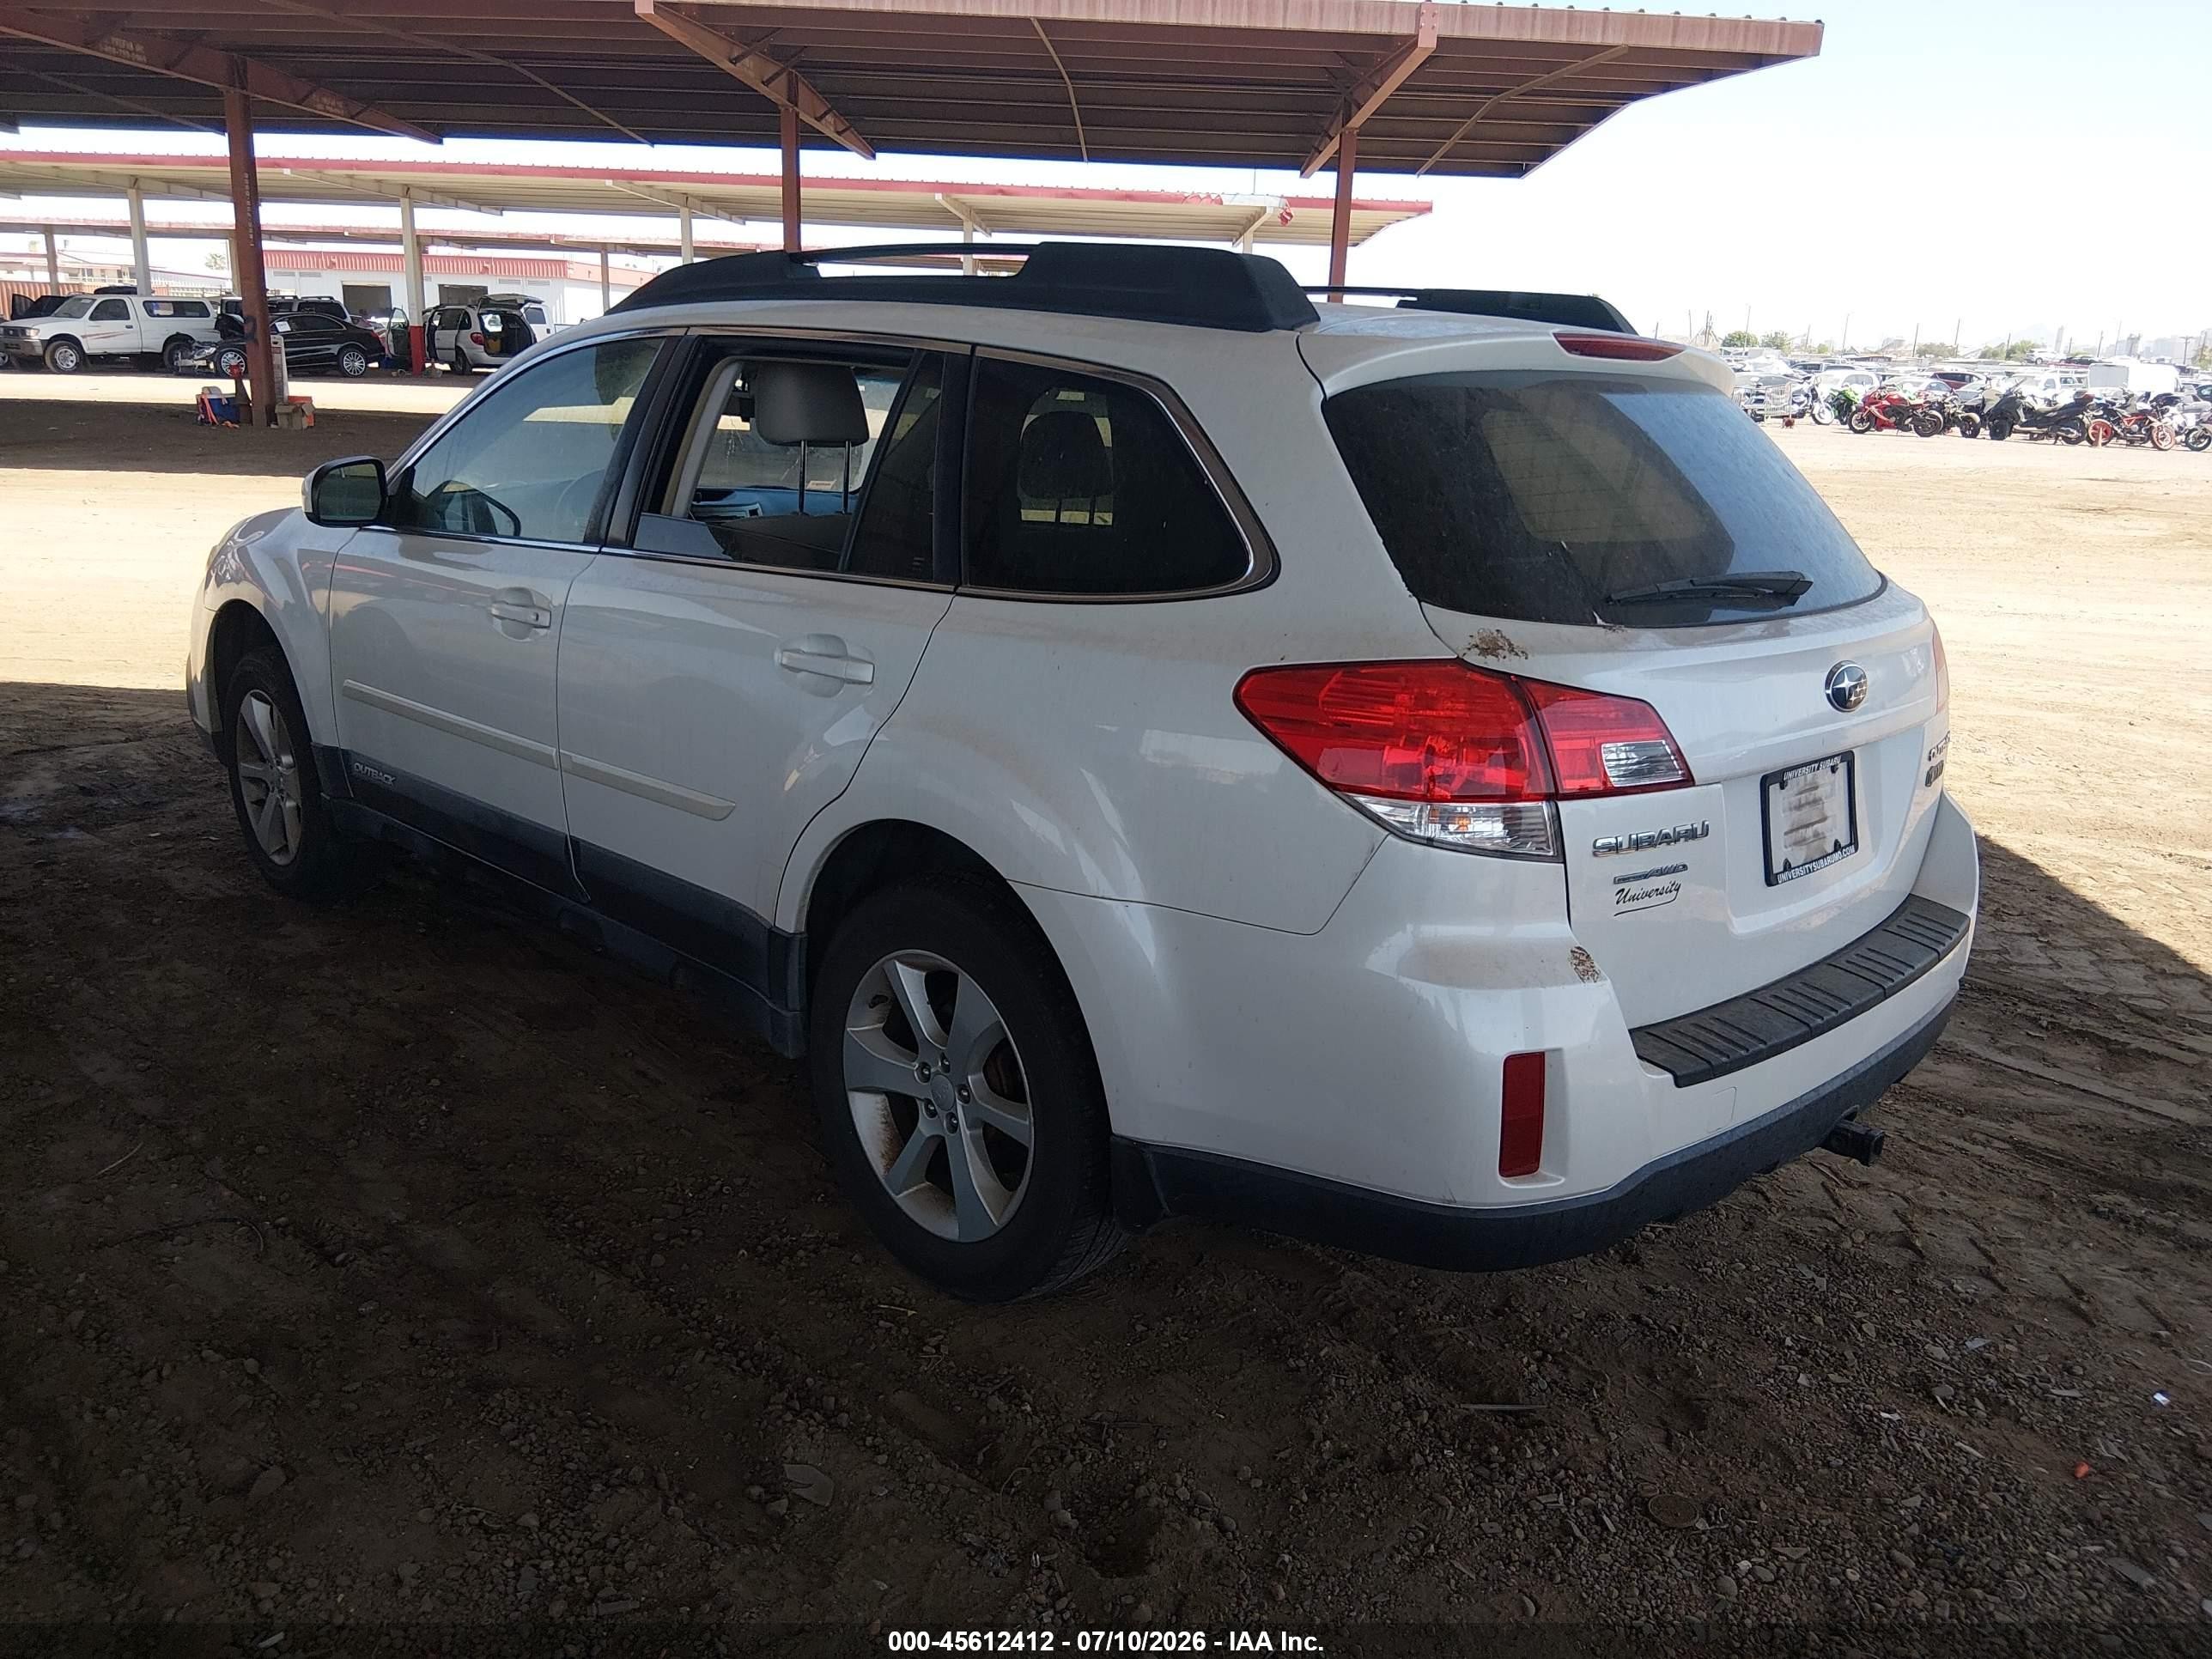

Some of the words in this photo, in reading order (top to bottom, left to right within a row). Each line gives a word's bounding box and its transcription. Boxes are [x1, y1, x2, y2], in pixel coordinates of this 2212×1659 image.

[354, 762, 396, 785] OUTBACK
[1784, 762, 1819, 781] UNIVERSITY
[1820, 756, 1841, 770] SUBARU
[1593, 820, 1710, 857] SUBARU
[1777, 845, 1856, 884] UNIVERSITYSUBARUMO.COM
[1614, 880, 1681, 905] University
